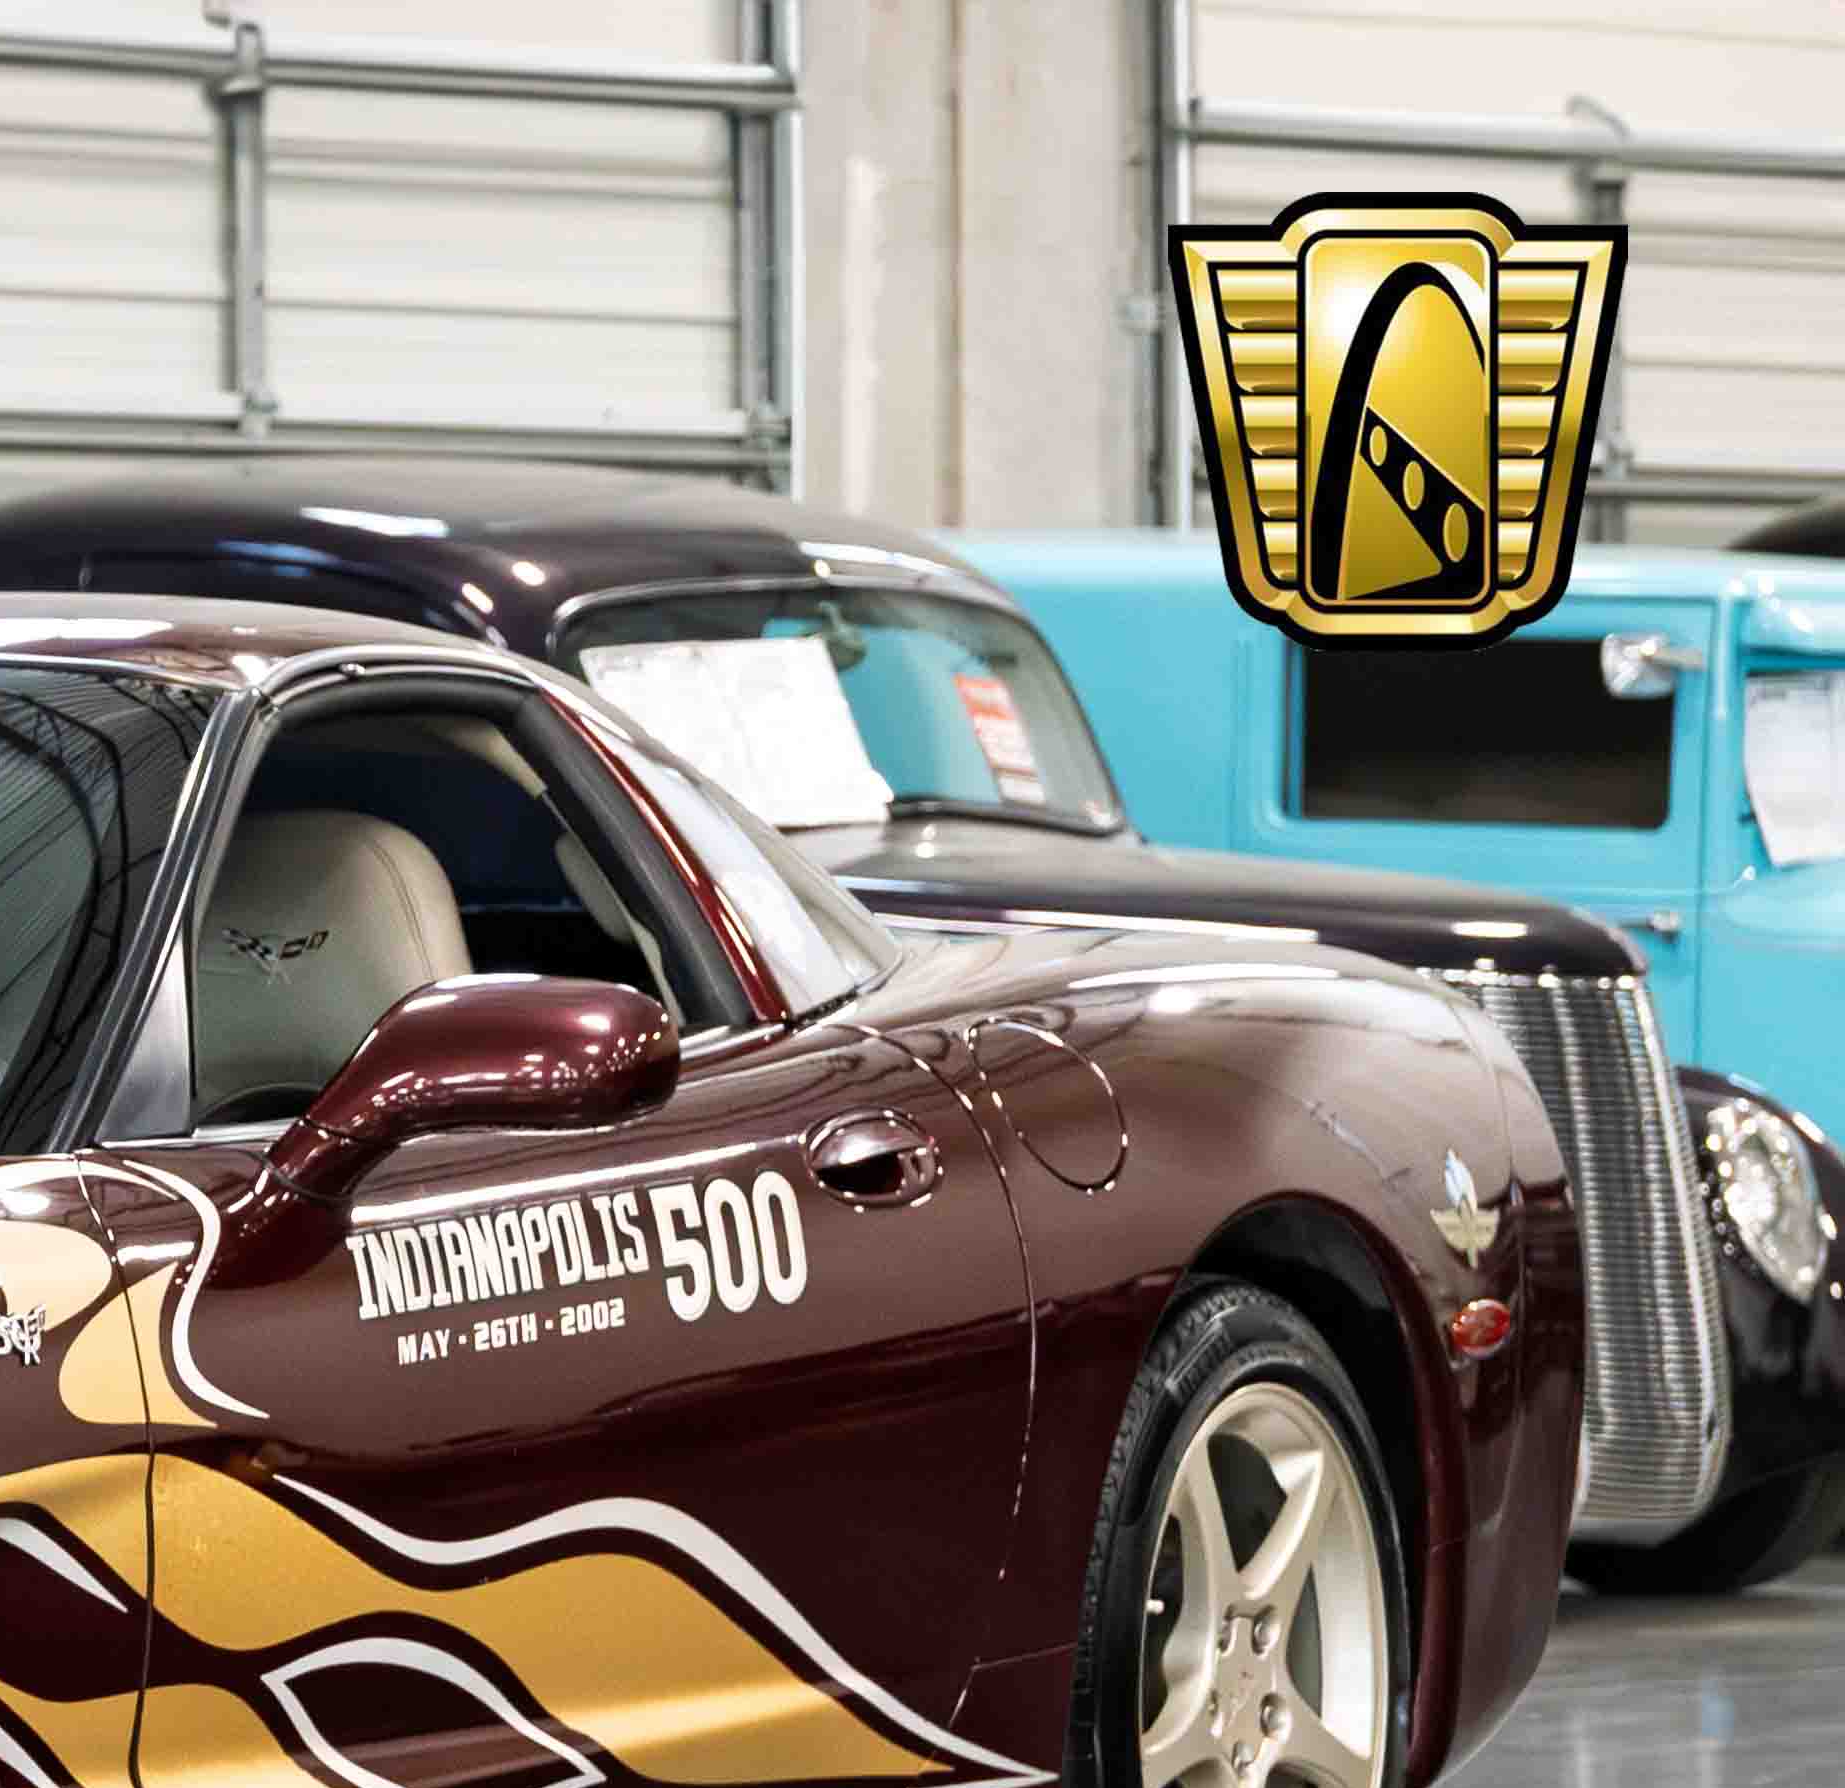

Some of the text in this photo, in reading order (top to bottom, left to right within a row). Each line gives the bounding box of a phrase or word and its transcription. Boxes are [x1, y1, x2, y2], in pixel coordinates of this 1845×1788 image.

[345, 1169, 809, 1322] INDIANAPOLIS 500
[396, 1297, 626, 1366] MAY 26TH 2002
